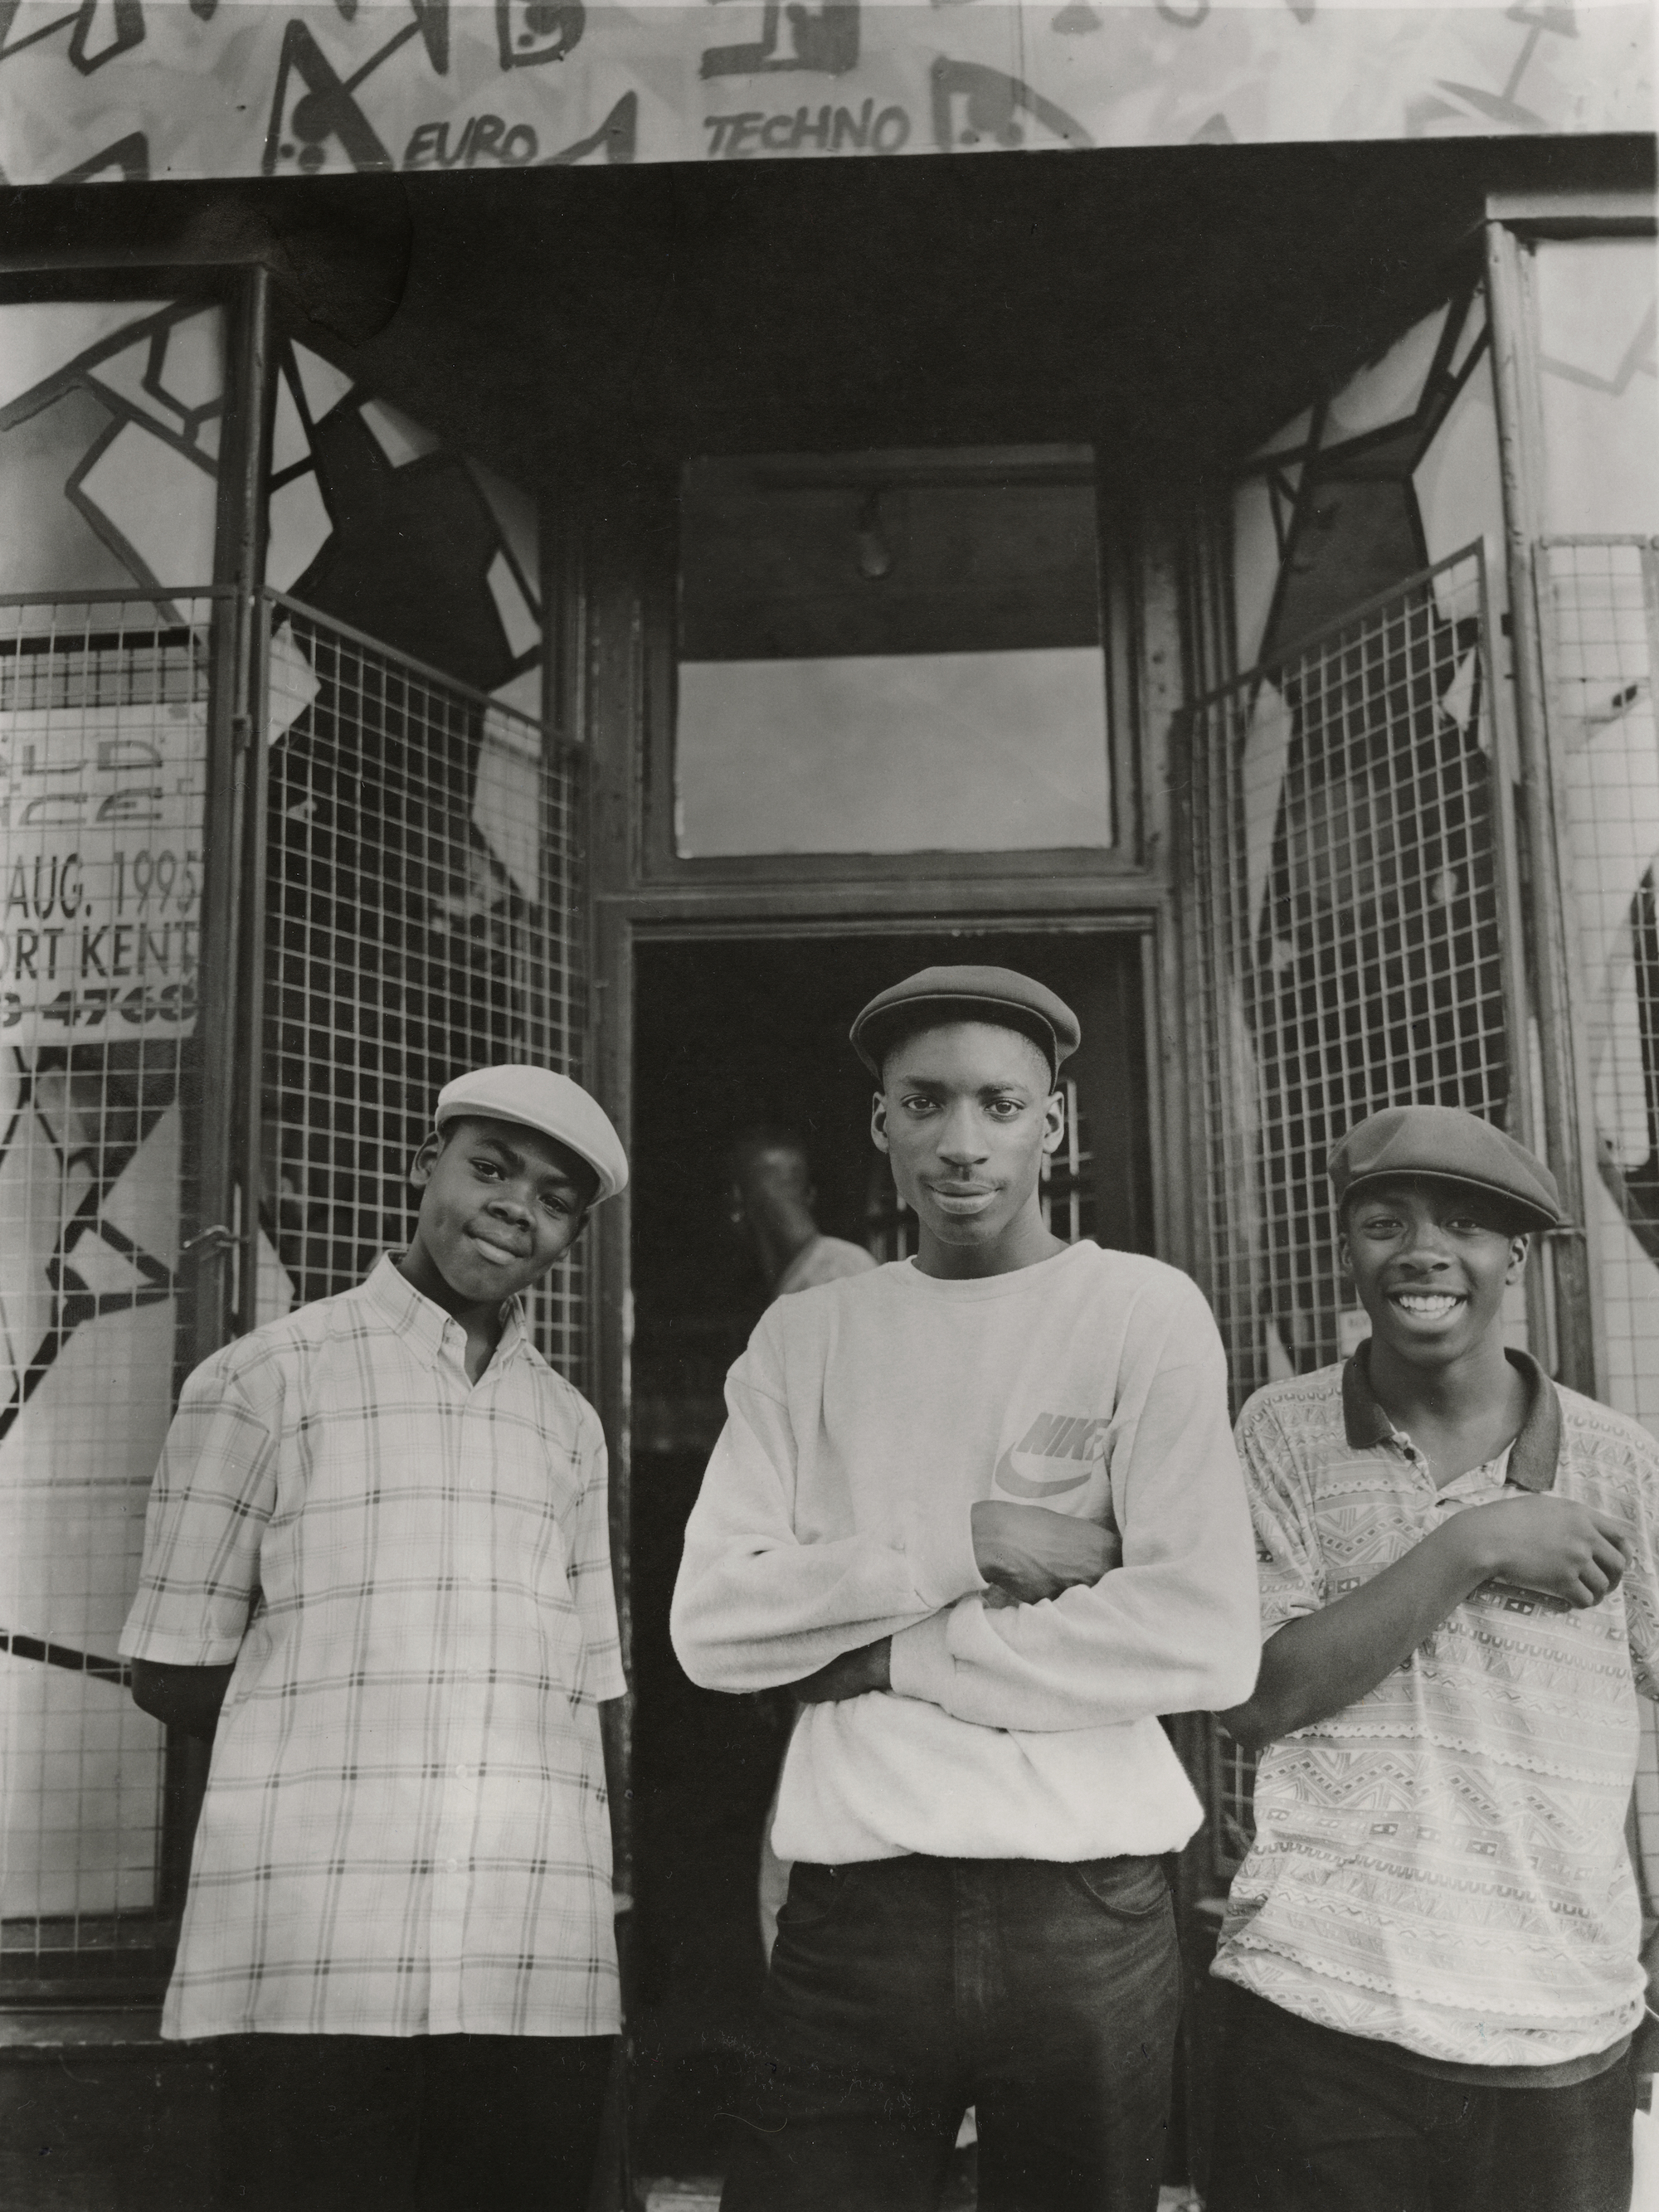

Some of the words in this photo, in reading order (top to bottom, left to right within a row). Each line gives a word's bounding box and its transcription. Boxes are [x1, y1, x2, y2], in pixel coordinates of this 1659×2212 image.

[404, 114, 539, 171] EURO
[703, 97, 912, 158] TECHNO
[0, 739, 163, 776] LD
[7, 853, 92, 920] AUG.
[113, 849, 198, 916] 1995
[81, 921, 198, 979] KENT
